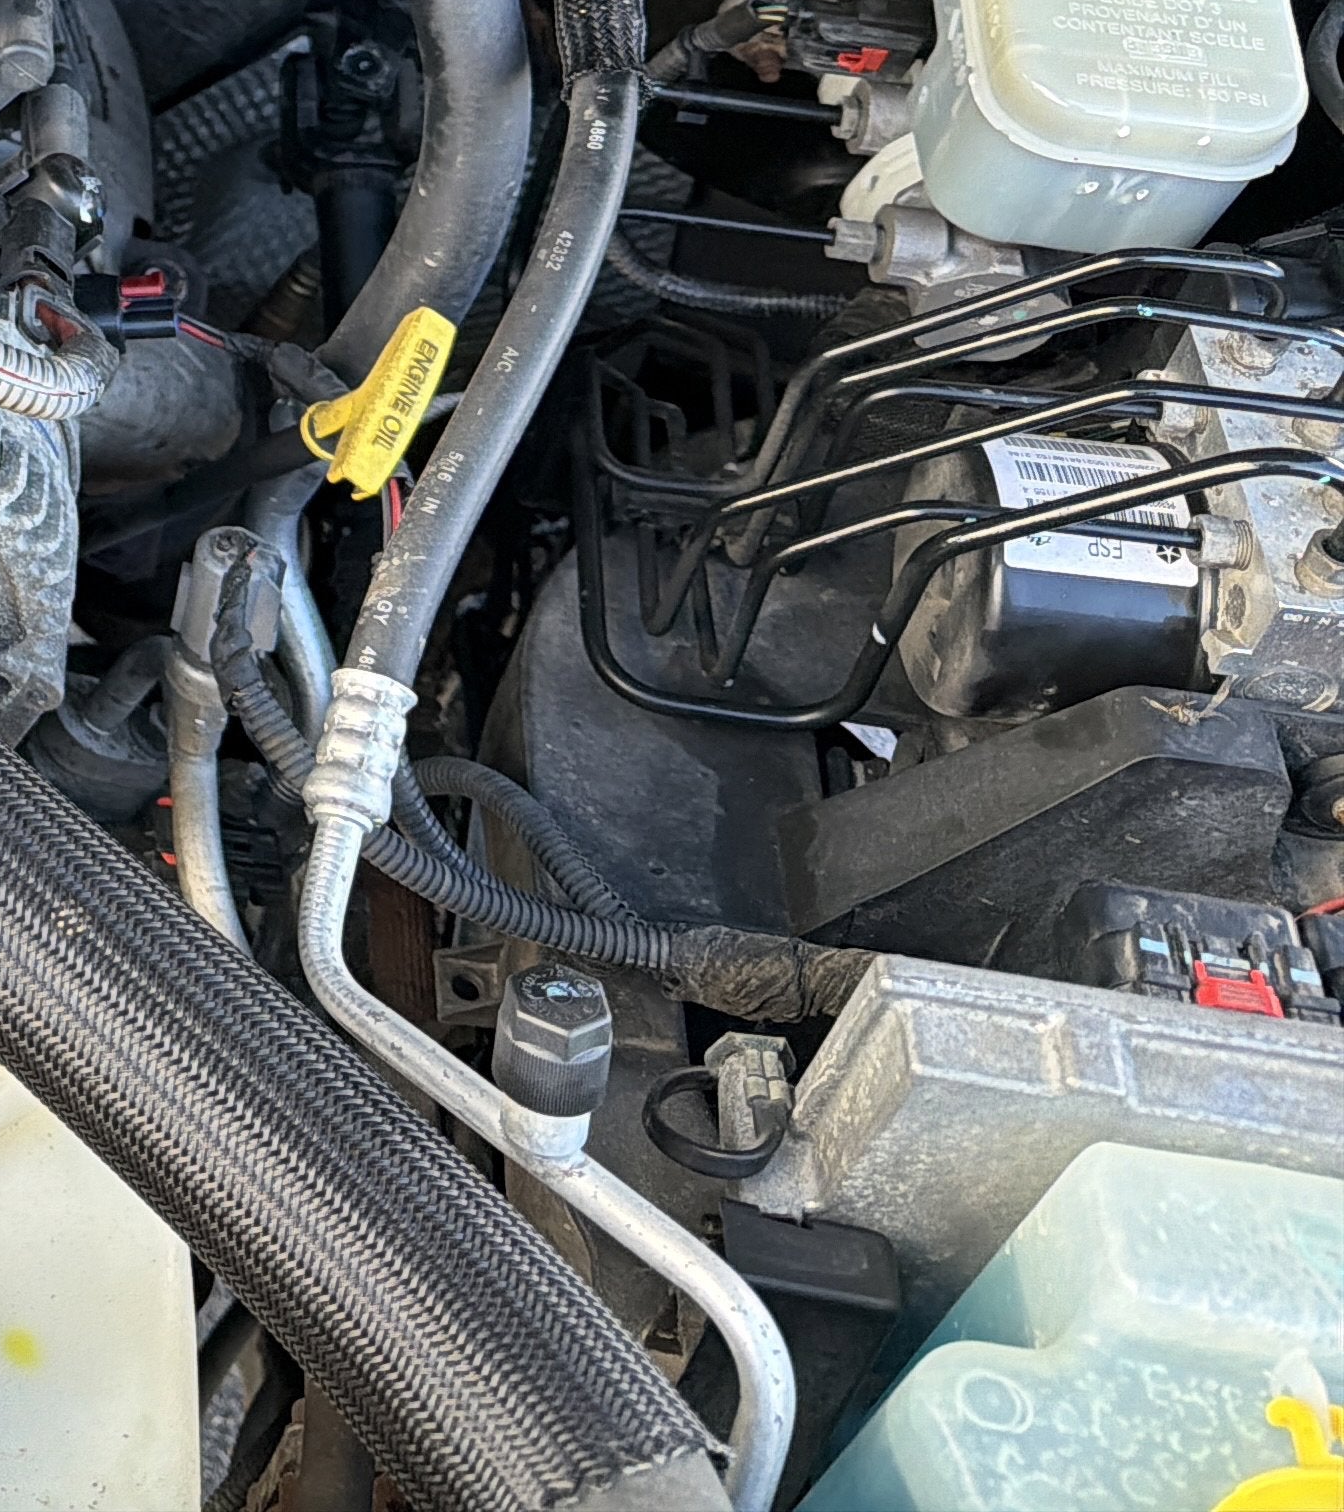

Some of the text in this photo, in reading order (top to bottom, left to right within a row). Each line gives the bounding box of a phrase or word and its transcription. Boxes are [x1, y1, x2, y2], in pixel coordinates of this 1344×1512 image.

[1052, 15, 1266, 51] CONTENTANT SCELLE
[1068, 2, 1189, 26] PROVENANT
[1217, 18, 1249, 33] UN
[1097, 60, 1240, 88] MAXIMUM FILL
[1235, 92, 1269, 108] PSI
[586, 119, 607, 151] 4860
[372, 338, 439, 451] ENGINE OIL
[420, 450, 464, 516] 5/16 IN
[373, 600, 394, 626] GY
